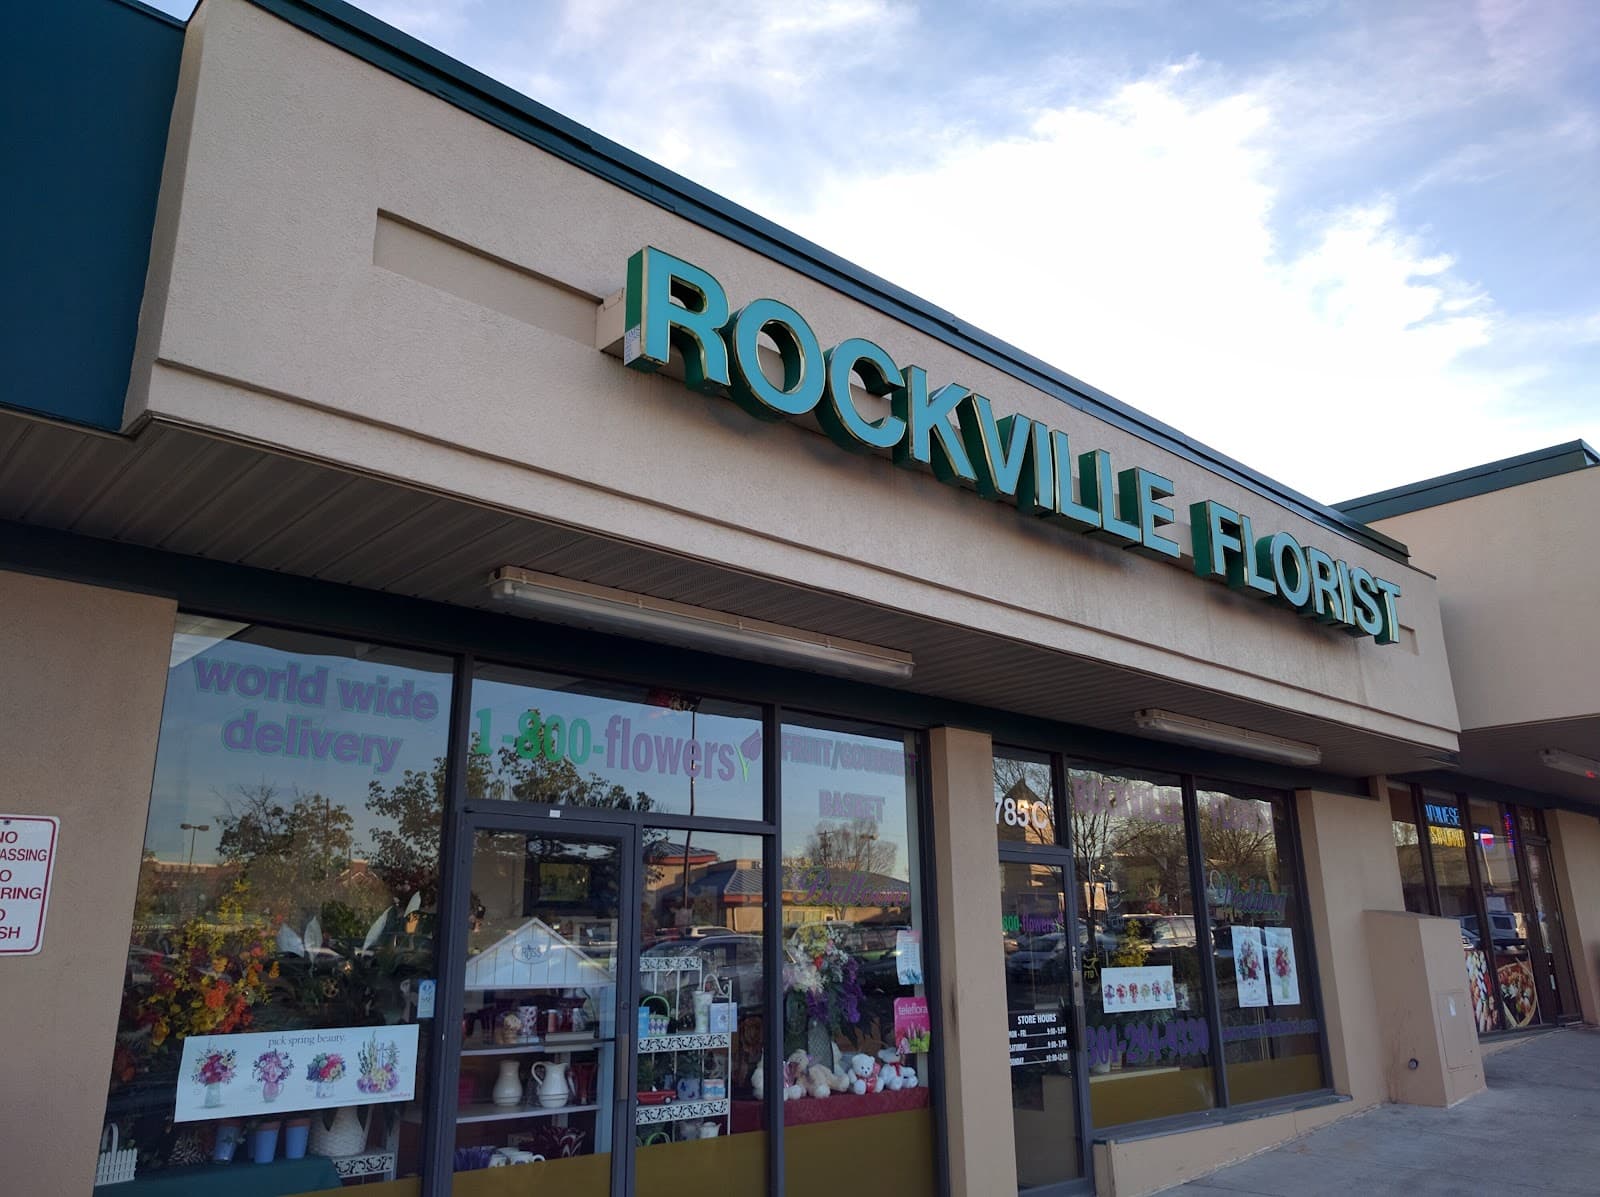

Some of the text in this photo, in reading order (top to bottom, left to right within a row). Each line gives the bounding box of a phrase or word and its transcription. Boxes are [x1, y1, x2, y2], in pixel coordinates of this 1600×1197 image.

[625, 246, 1401, 645] ROCKVILLE FLORIST
[193, 657, 439, 721] world wide
[222, 709, 402, 774] delivery
[474, 708, 736, 783] 1-800-flowers
[819, 789, 886, 824] BASKET
[268, 1033, 346, 1048] pick spring beauty
[1017, 1013, 1057, 1024] STORE HOURS
